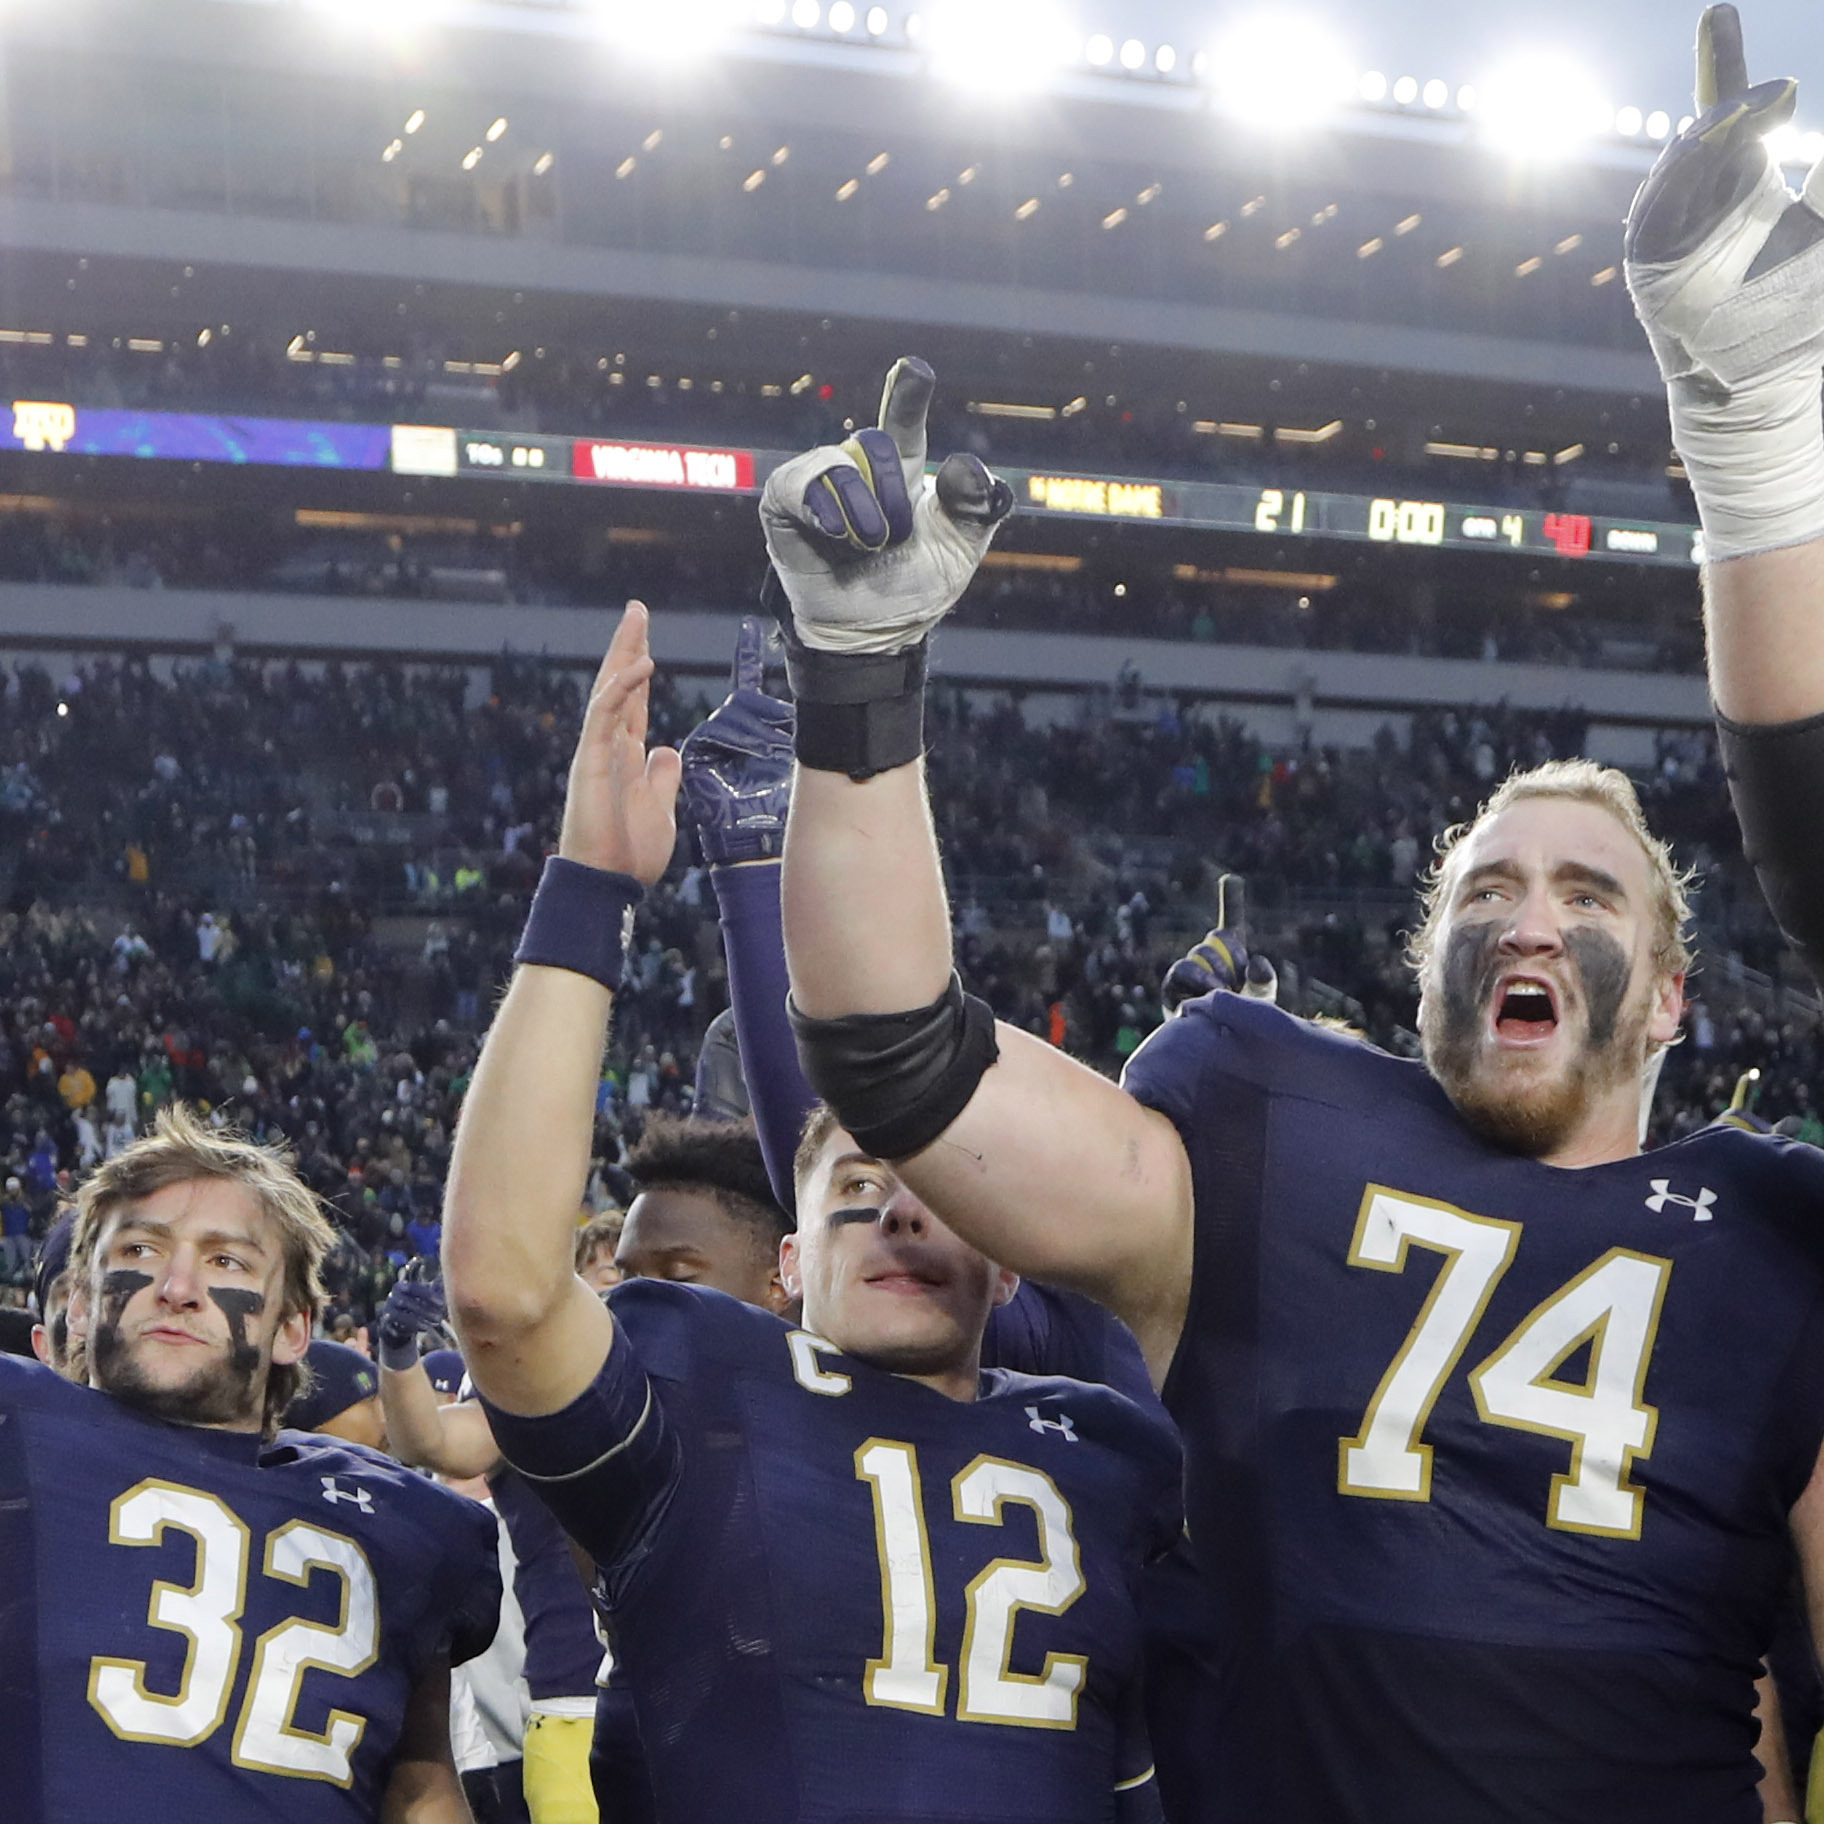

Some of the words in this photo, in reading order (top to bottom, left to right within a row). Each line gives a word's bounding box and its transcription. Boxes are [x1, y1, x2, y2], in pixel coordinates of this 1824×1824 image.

[591, 445, 684, 485] VIRGINIA
[684, 450, 737, 489] TECH
[1254, 489, 1306, 535] 21
[1368, 498, 1445, 546] 0:00
[1501, 514, 1524, 548] 4
[785, 1330, 853, 1397] C
[1338, 1183, 1674, 1541] 74
[854, 1437, 1088, 1730] 12
[87, 1477, 380, 1789] 32
